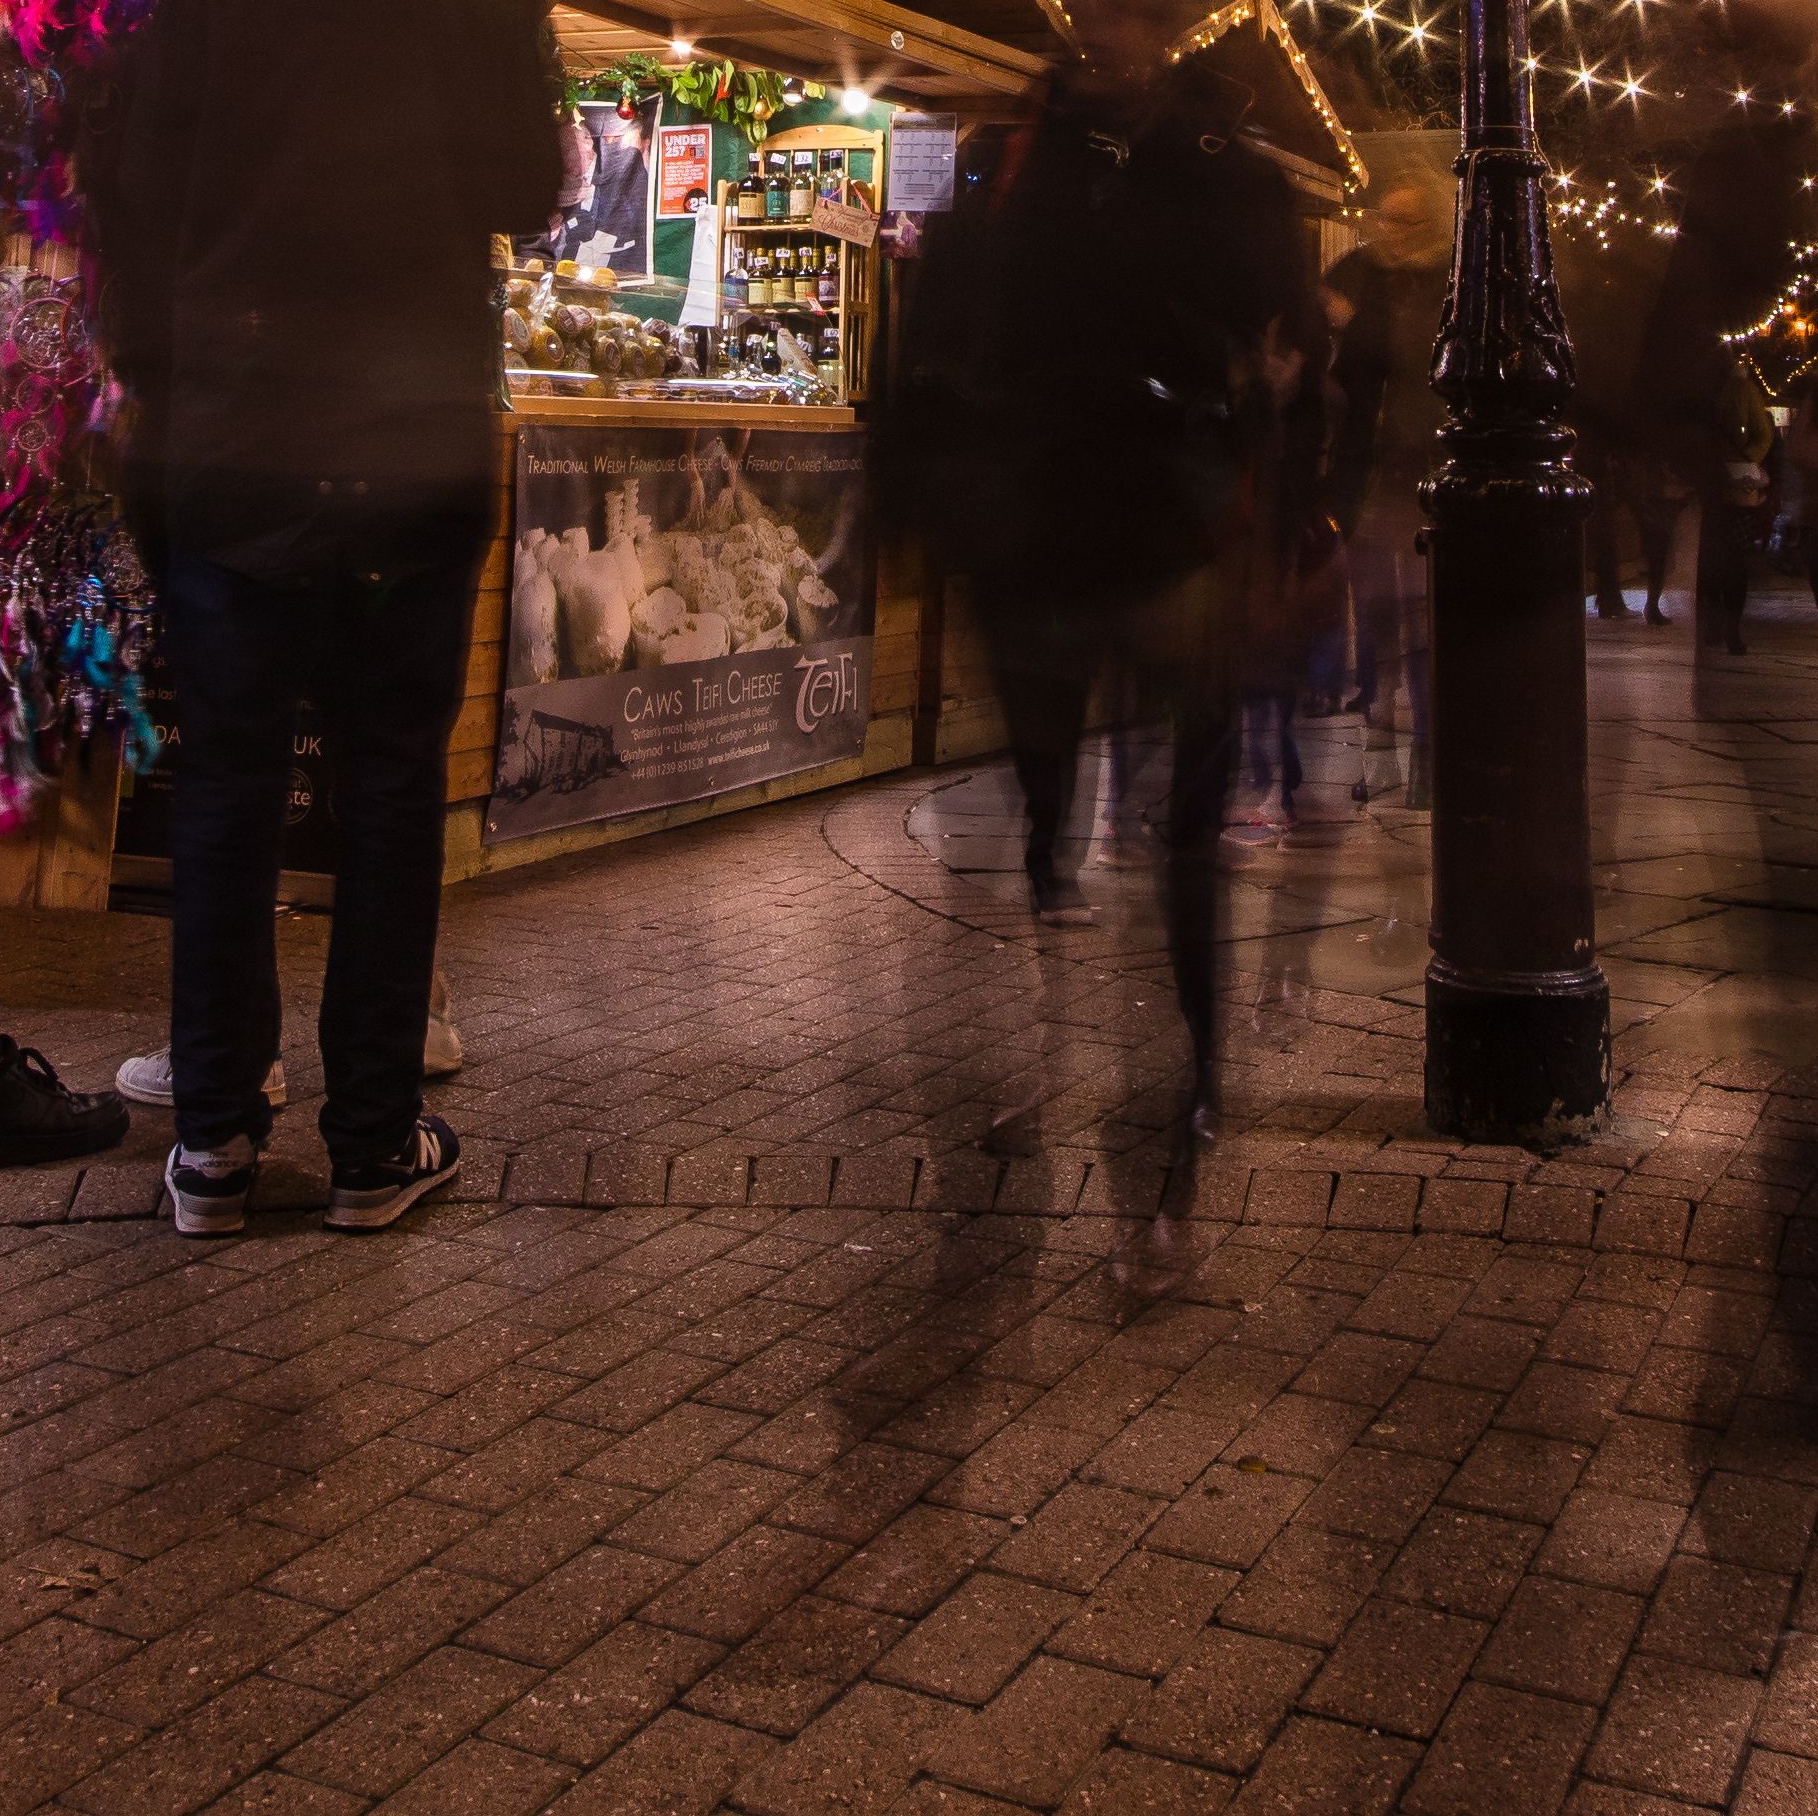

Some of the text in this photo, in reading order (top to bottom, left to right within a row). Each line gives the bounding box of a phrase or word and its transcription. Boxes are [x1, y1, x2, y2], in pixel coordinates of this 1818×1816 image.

[665, 133, 706, 145] UNDER
[528, 455, 589, 474] TRADITIONAL
[594, 455, 627, 474] WELSH
[629, 455, 676, 474] FARMHOUSE
[624, 670, 783, 723] CAWS TEIFI CHEESE
